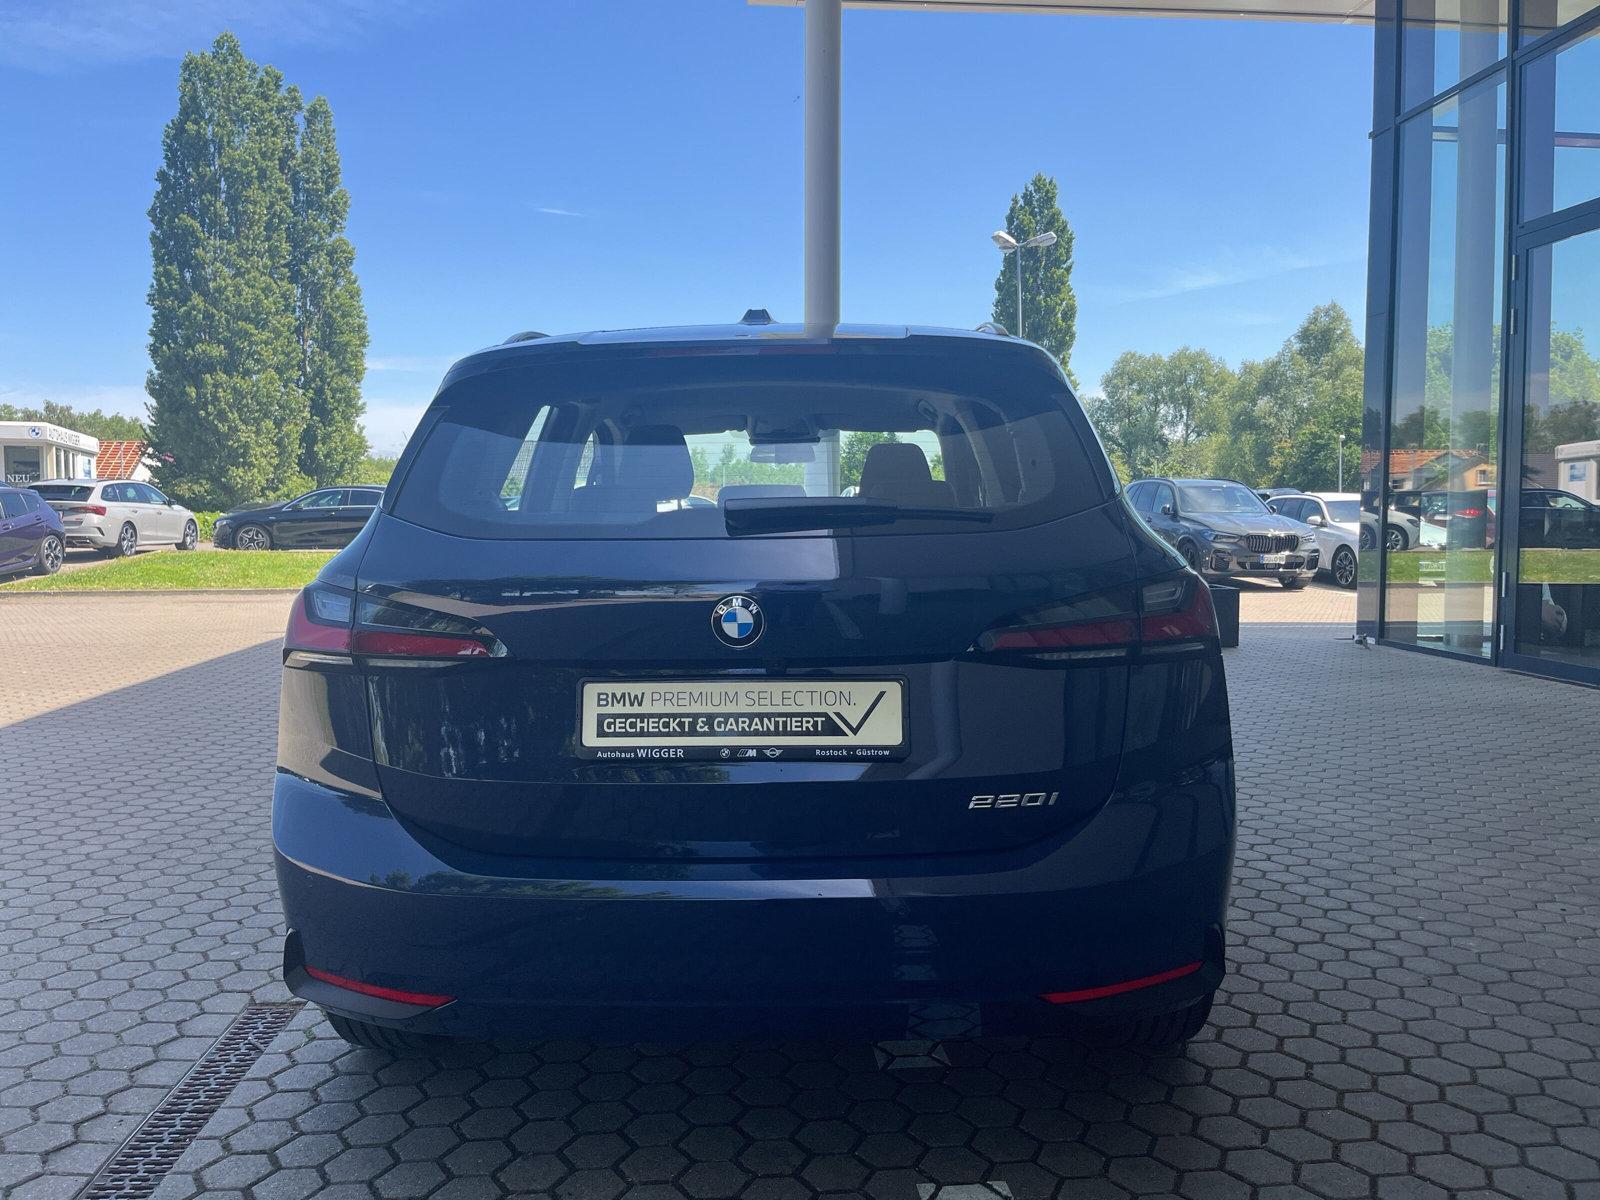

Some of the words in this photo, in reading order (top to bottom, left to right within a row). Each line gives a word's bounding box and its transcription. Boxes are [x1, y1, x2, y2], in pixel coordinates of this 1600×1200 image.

[716, 598, 759, 615] BMW
[597, 692, 645, 707] BMW
[651, 691, 739, 707] PREMIUM
[745, 690, 856, 707] SELECTION.
[603, 718, 692, 733] GECHECKT
[696, 717, 710, 732] &
[713, 717, 826, 732] GARANTIERT
[596, 750, 635, 758] Autohaus
[636, 748, 684, 758] WIGGER
[856, 748, 890, 757] Güstrow
